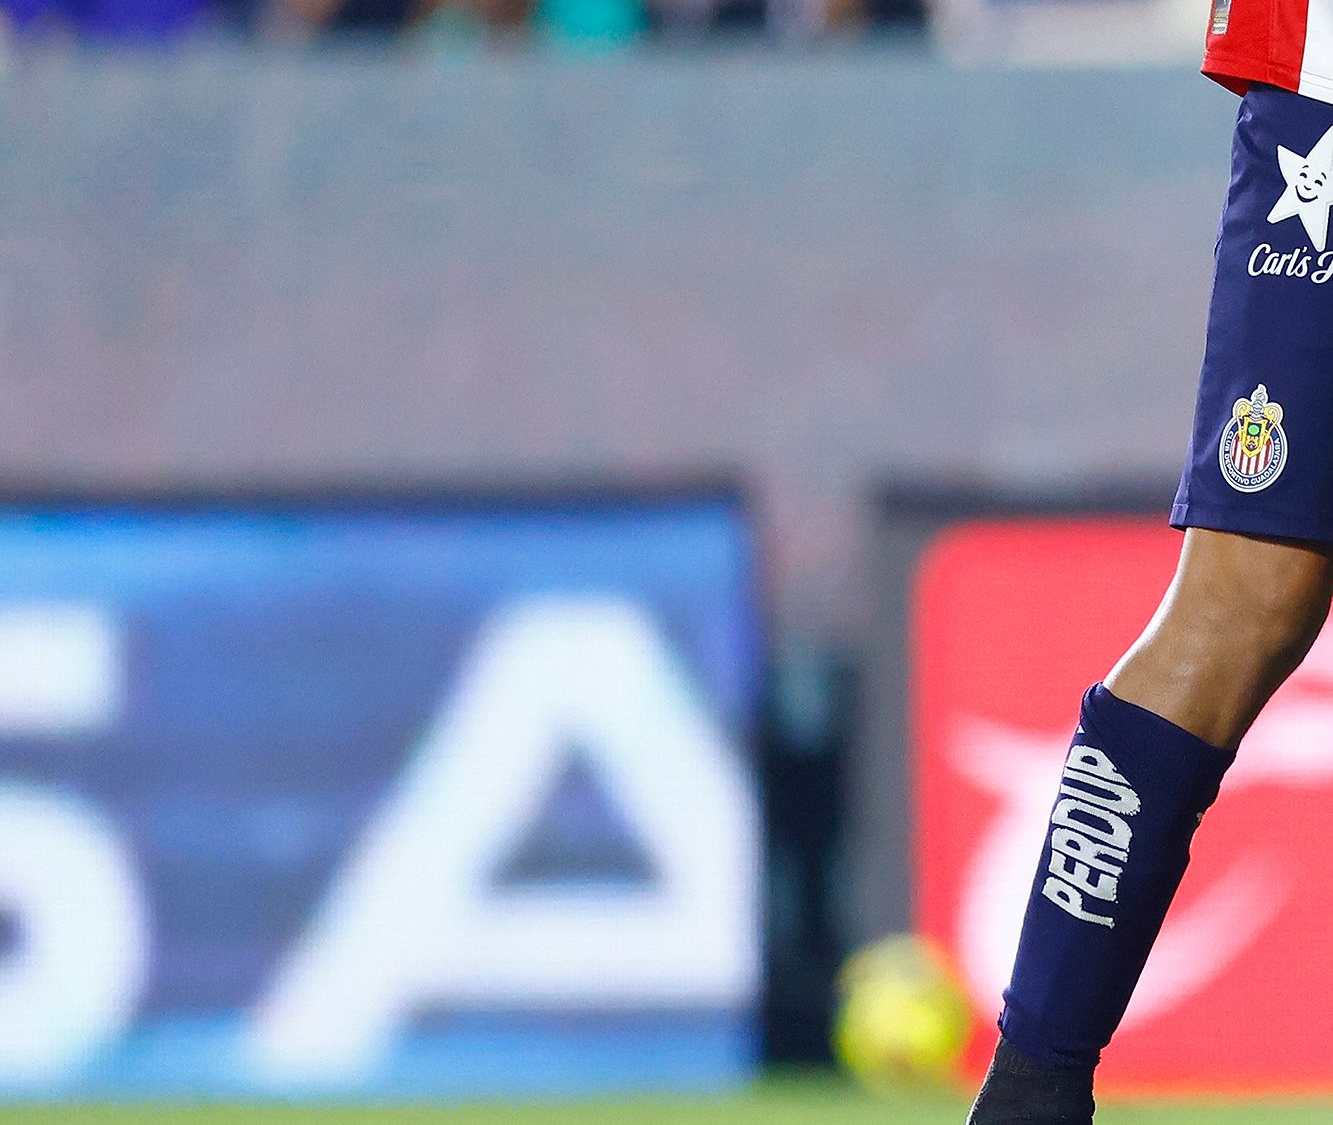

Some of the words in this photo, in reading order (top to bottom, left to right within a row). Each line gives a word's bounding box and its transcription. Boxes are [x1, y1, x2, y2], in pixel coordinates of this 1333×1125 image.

[1248, 243, 1311, 277] Carl's
[1224, 431, 1234, 452] CLUB
[1224, 453, 1250, 485] DEPORTIVO
[1250, 437, 1281, 485] GUADALAJARA
[0, 592, 764, 1085] A
